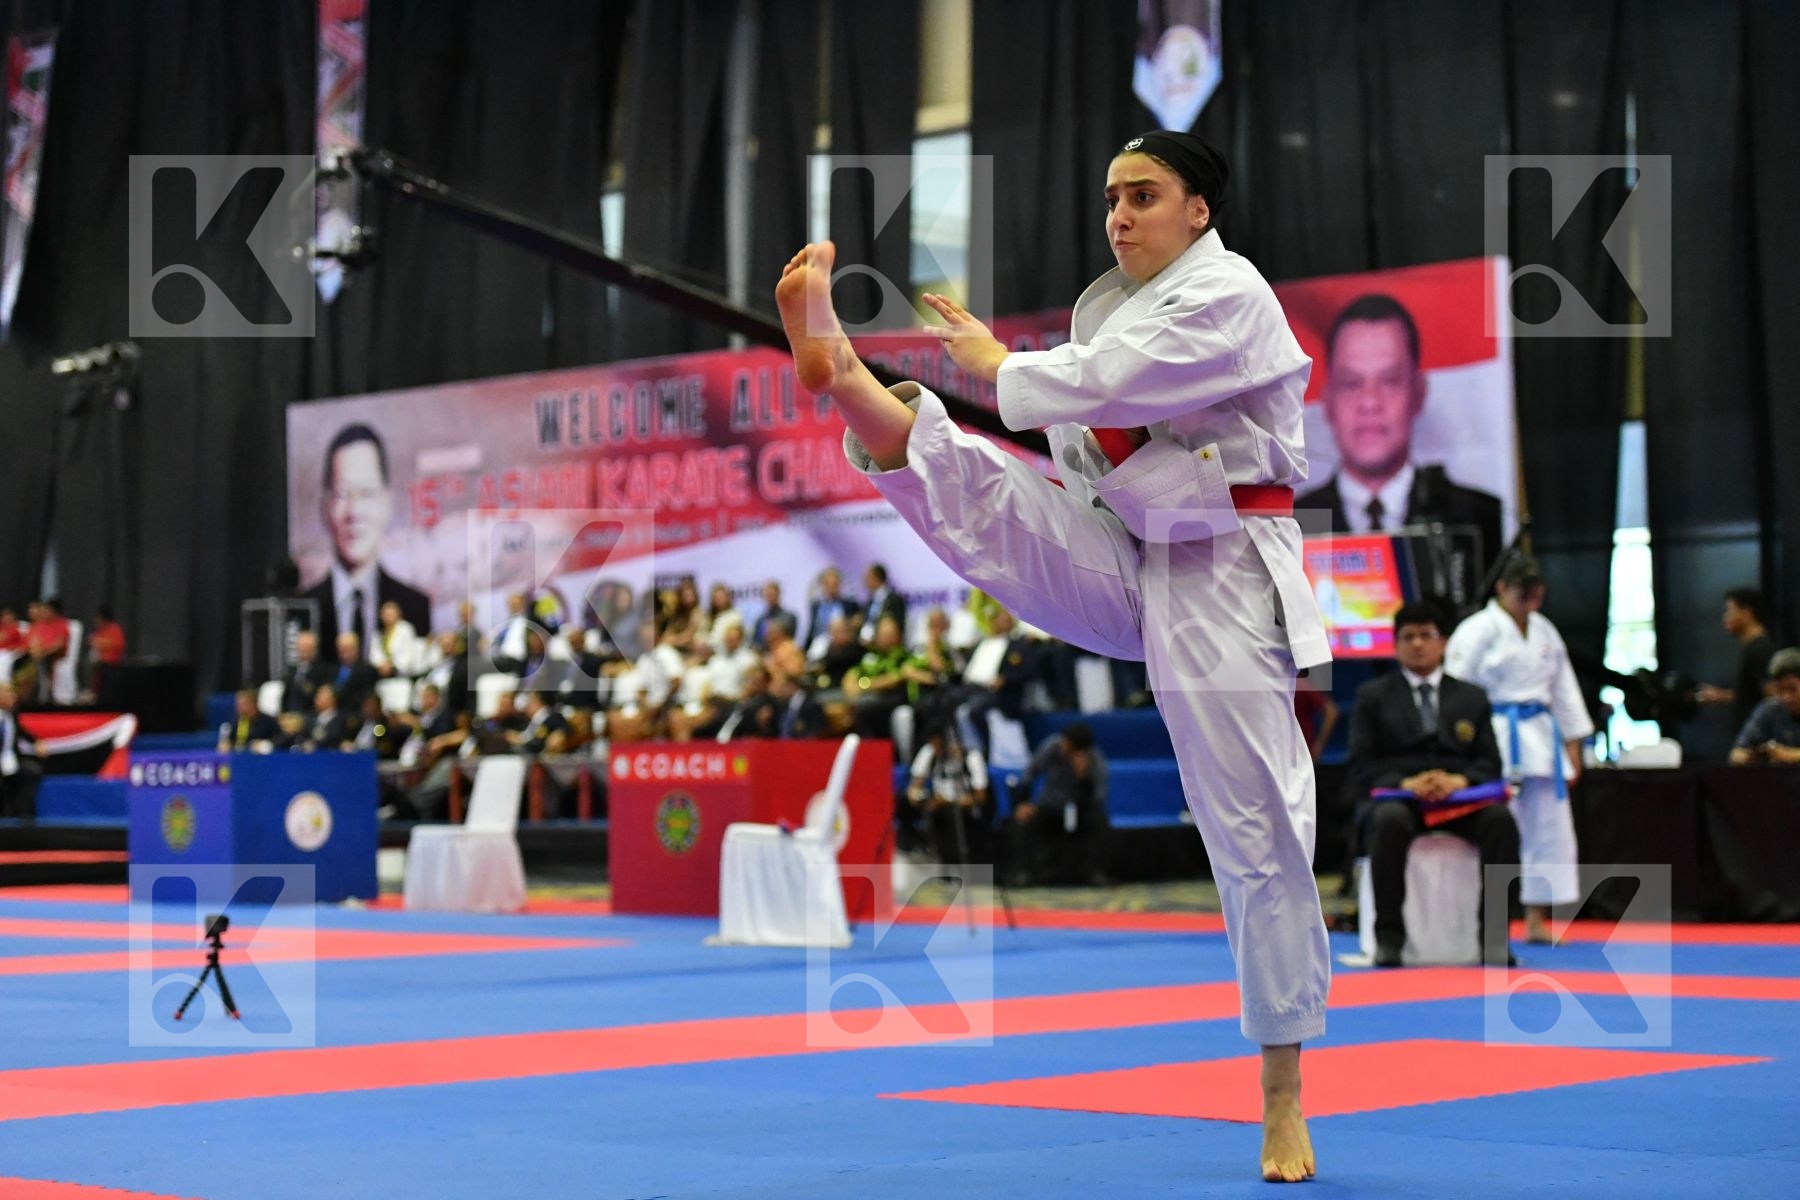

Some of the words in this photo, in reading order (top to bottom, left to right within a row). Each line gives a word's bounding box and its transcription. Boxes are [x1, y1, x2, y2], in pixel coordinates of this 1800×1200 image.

[536, 373, 706, 448] WELCOME
[729, 363, 799, 432] ALL
[597, 445, 750, 514] KARATE
[145, 762, 214, 786] COACH
[633, 753, 726, 779] COACH
